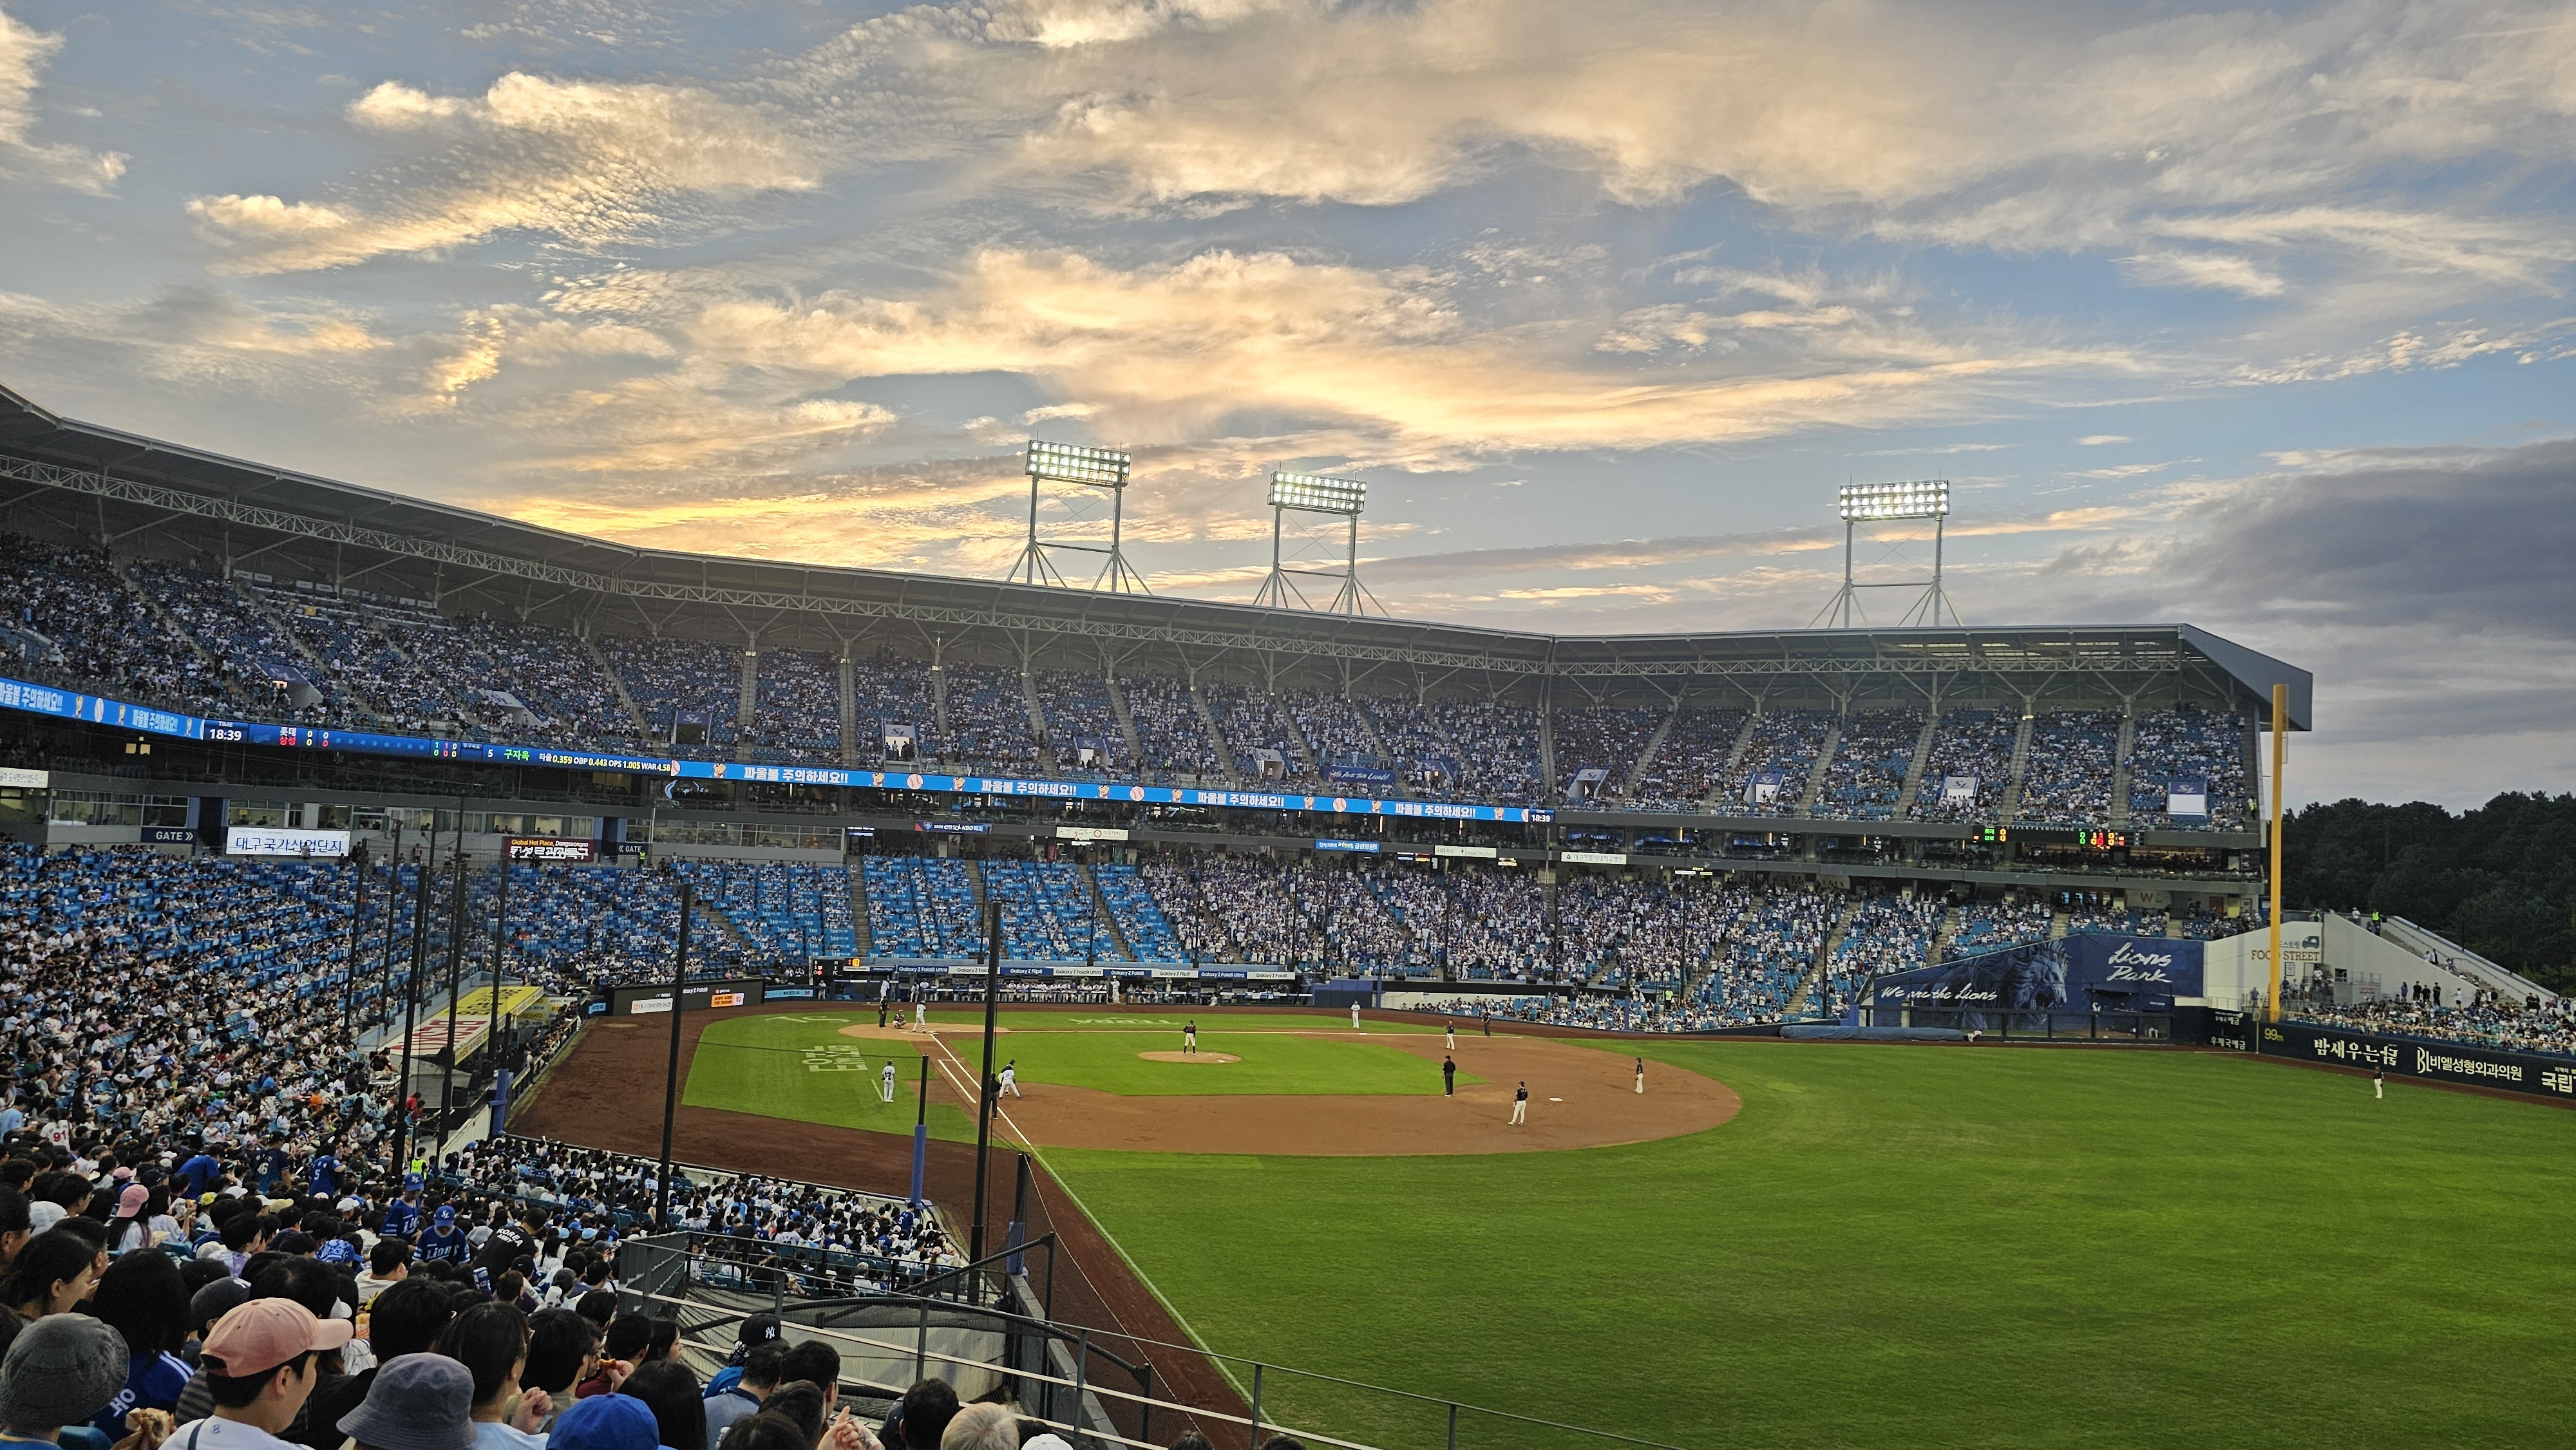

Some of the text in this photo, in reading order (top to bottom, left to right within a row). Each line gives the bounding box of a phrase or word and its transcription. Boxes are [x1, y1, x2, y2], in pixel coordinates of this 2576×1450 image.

[22, 686, 62, 712] 주의하세요!!
[149, 712, 178, 732] 주의하세요!!
[209, 729, 242, 740] 18:39
[280, 727, 297, 737] 롯데
[279, 737, 296, 746] 삼성
[488, 749, 493, 758] 5
[504, 749, 530, 761] 구자욱
[553, 755, 573, 764] 0.359
[573, 757, 588, 765] OBP
[588, 758, 607, 767] 0.443
[609, 759, 622, 767] OPS
[623, 760, 641, 769] 1.005
[641, 762, 657, 770] WAR
[657, 762, 671, 772] 4.58
[744, 767, 848, 784] 파울볼 주의하세요!!
[981, 780, 1077, 796] 파울볼 주의하세요!!
[2178, 784, 2197, 793] SL
[1197, 792, 1284, 807] 파울볼 주의하세요!!
[1395, 803, 1475, 818] 파울볼 주의하세요!!
[1531, 814, 1551, 822] 18:39
[156, 832, 183, 841] GATE
[236, 837, 342, 854] 대구국가산업단지
[2108, 942, 2173, 966] Lions
[2251, 950, 2320, 961] FOO STREET
[2107, 965, 2173, 983] Park
[1880, 983, 1998, 1001] We are the Lions
[2264, 1028, 2284, 1042] 99m
[2210, 1036, 2246, 1050] 우체국예금
[2417, 1047, 2523, 1082] BL 비엘성형외과의원
[2541, 1071, 2576, 1094] 국립
[53, 1130, 66, 1142] 91
[257, 1162, 269, 1175] 46
[314, 1169, 321, 1180] 5
[440, 1210, 450, 1219] SL
[898, 1216, 904, 1225] 5
[497, 1229, 524, 1247] KOREA
[497, 1234, 513, 1243] ARMY
[426, 1245, 460, 1260] Lions
[766, 1326, 775, 1339] NY
